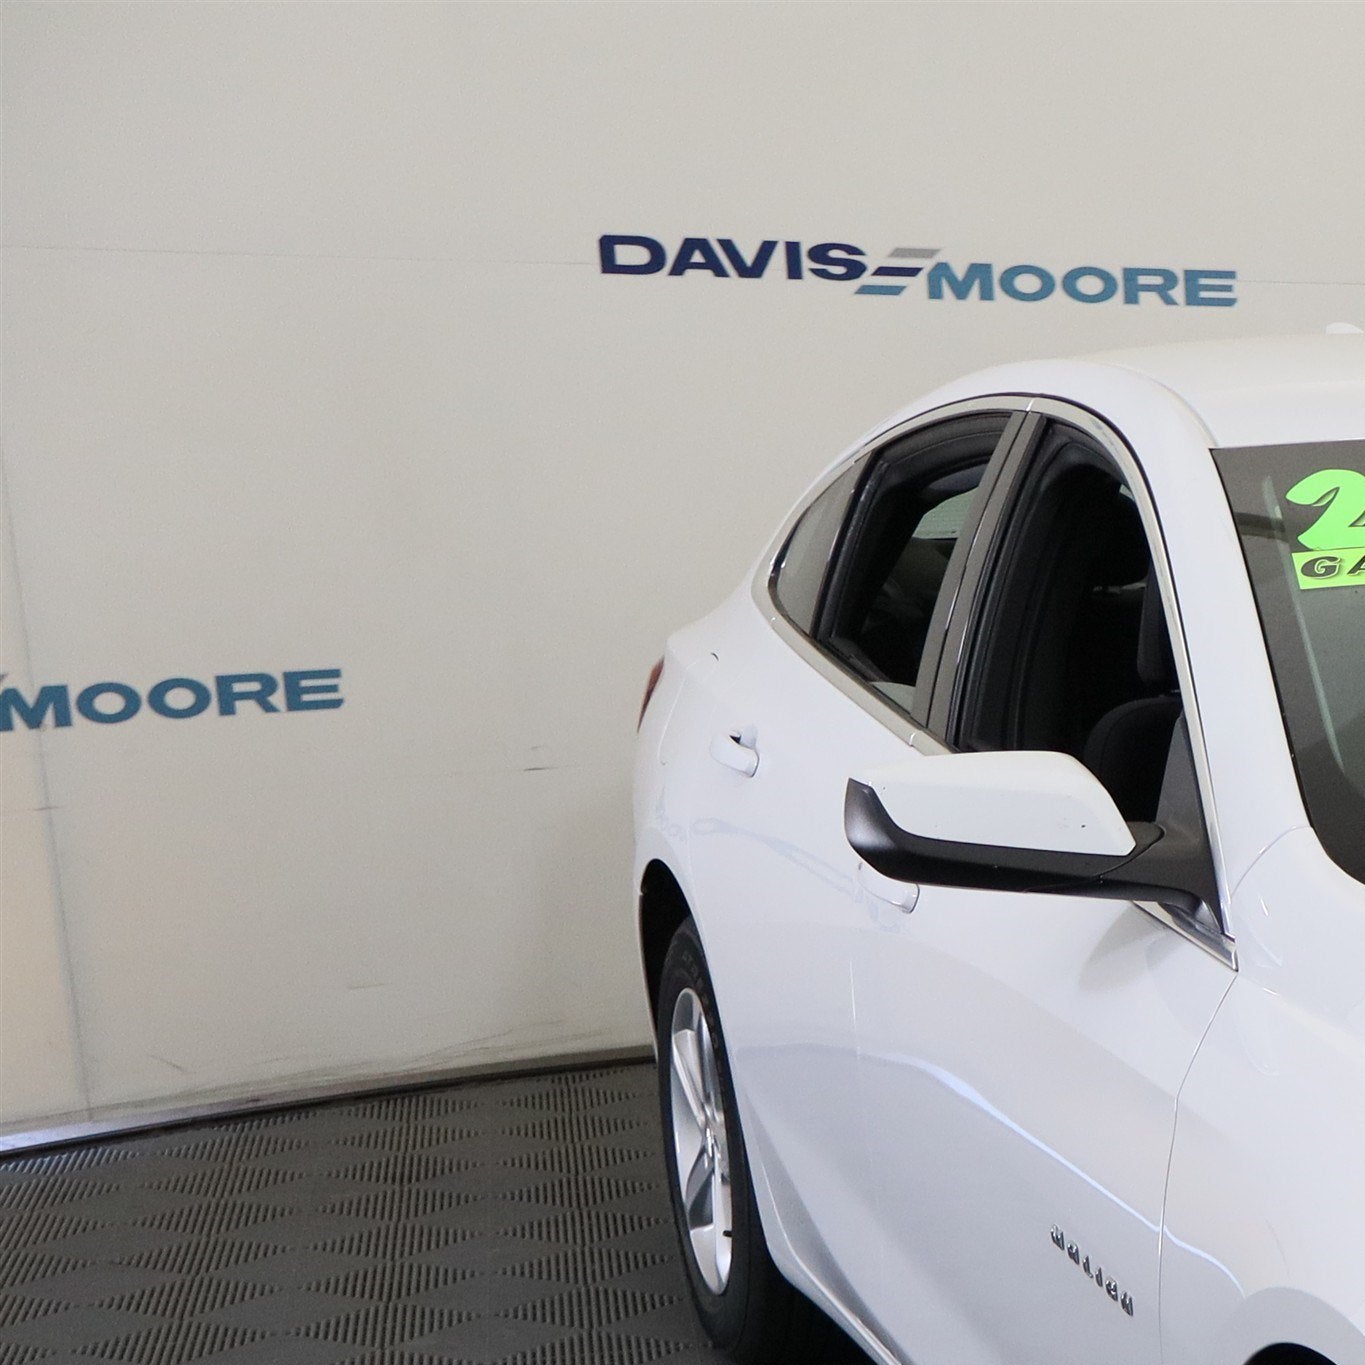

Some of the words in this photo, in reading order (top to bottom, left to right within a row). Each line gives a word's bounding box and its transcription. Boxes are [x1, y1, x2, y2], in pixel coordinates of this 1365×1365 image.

[598, 234, 867, 283] DAVIS
[926, 261, 1238, 307] MOORE
[0, 668, 345, 732] MOORE
